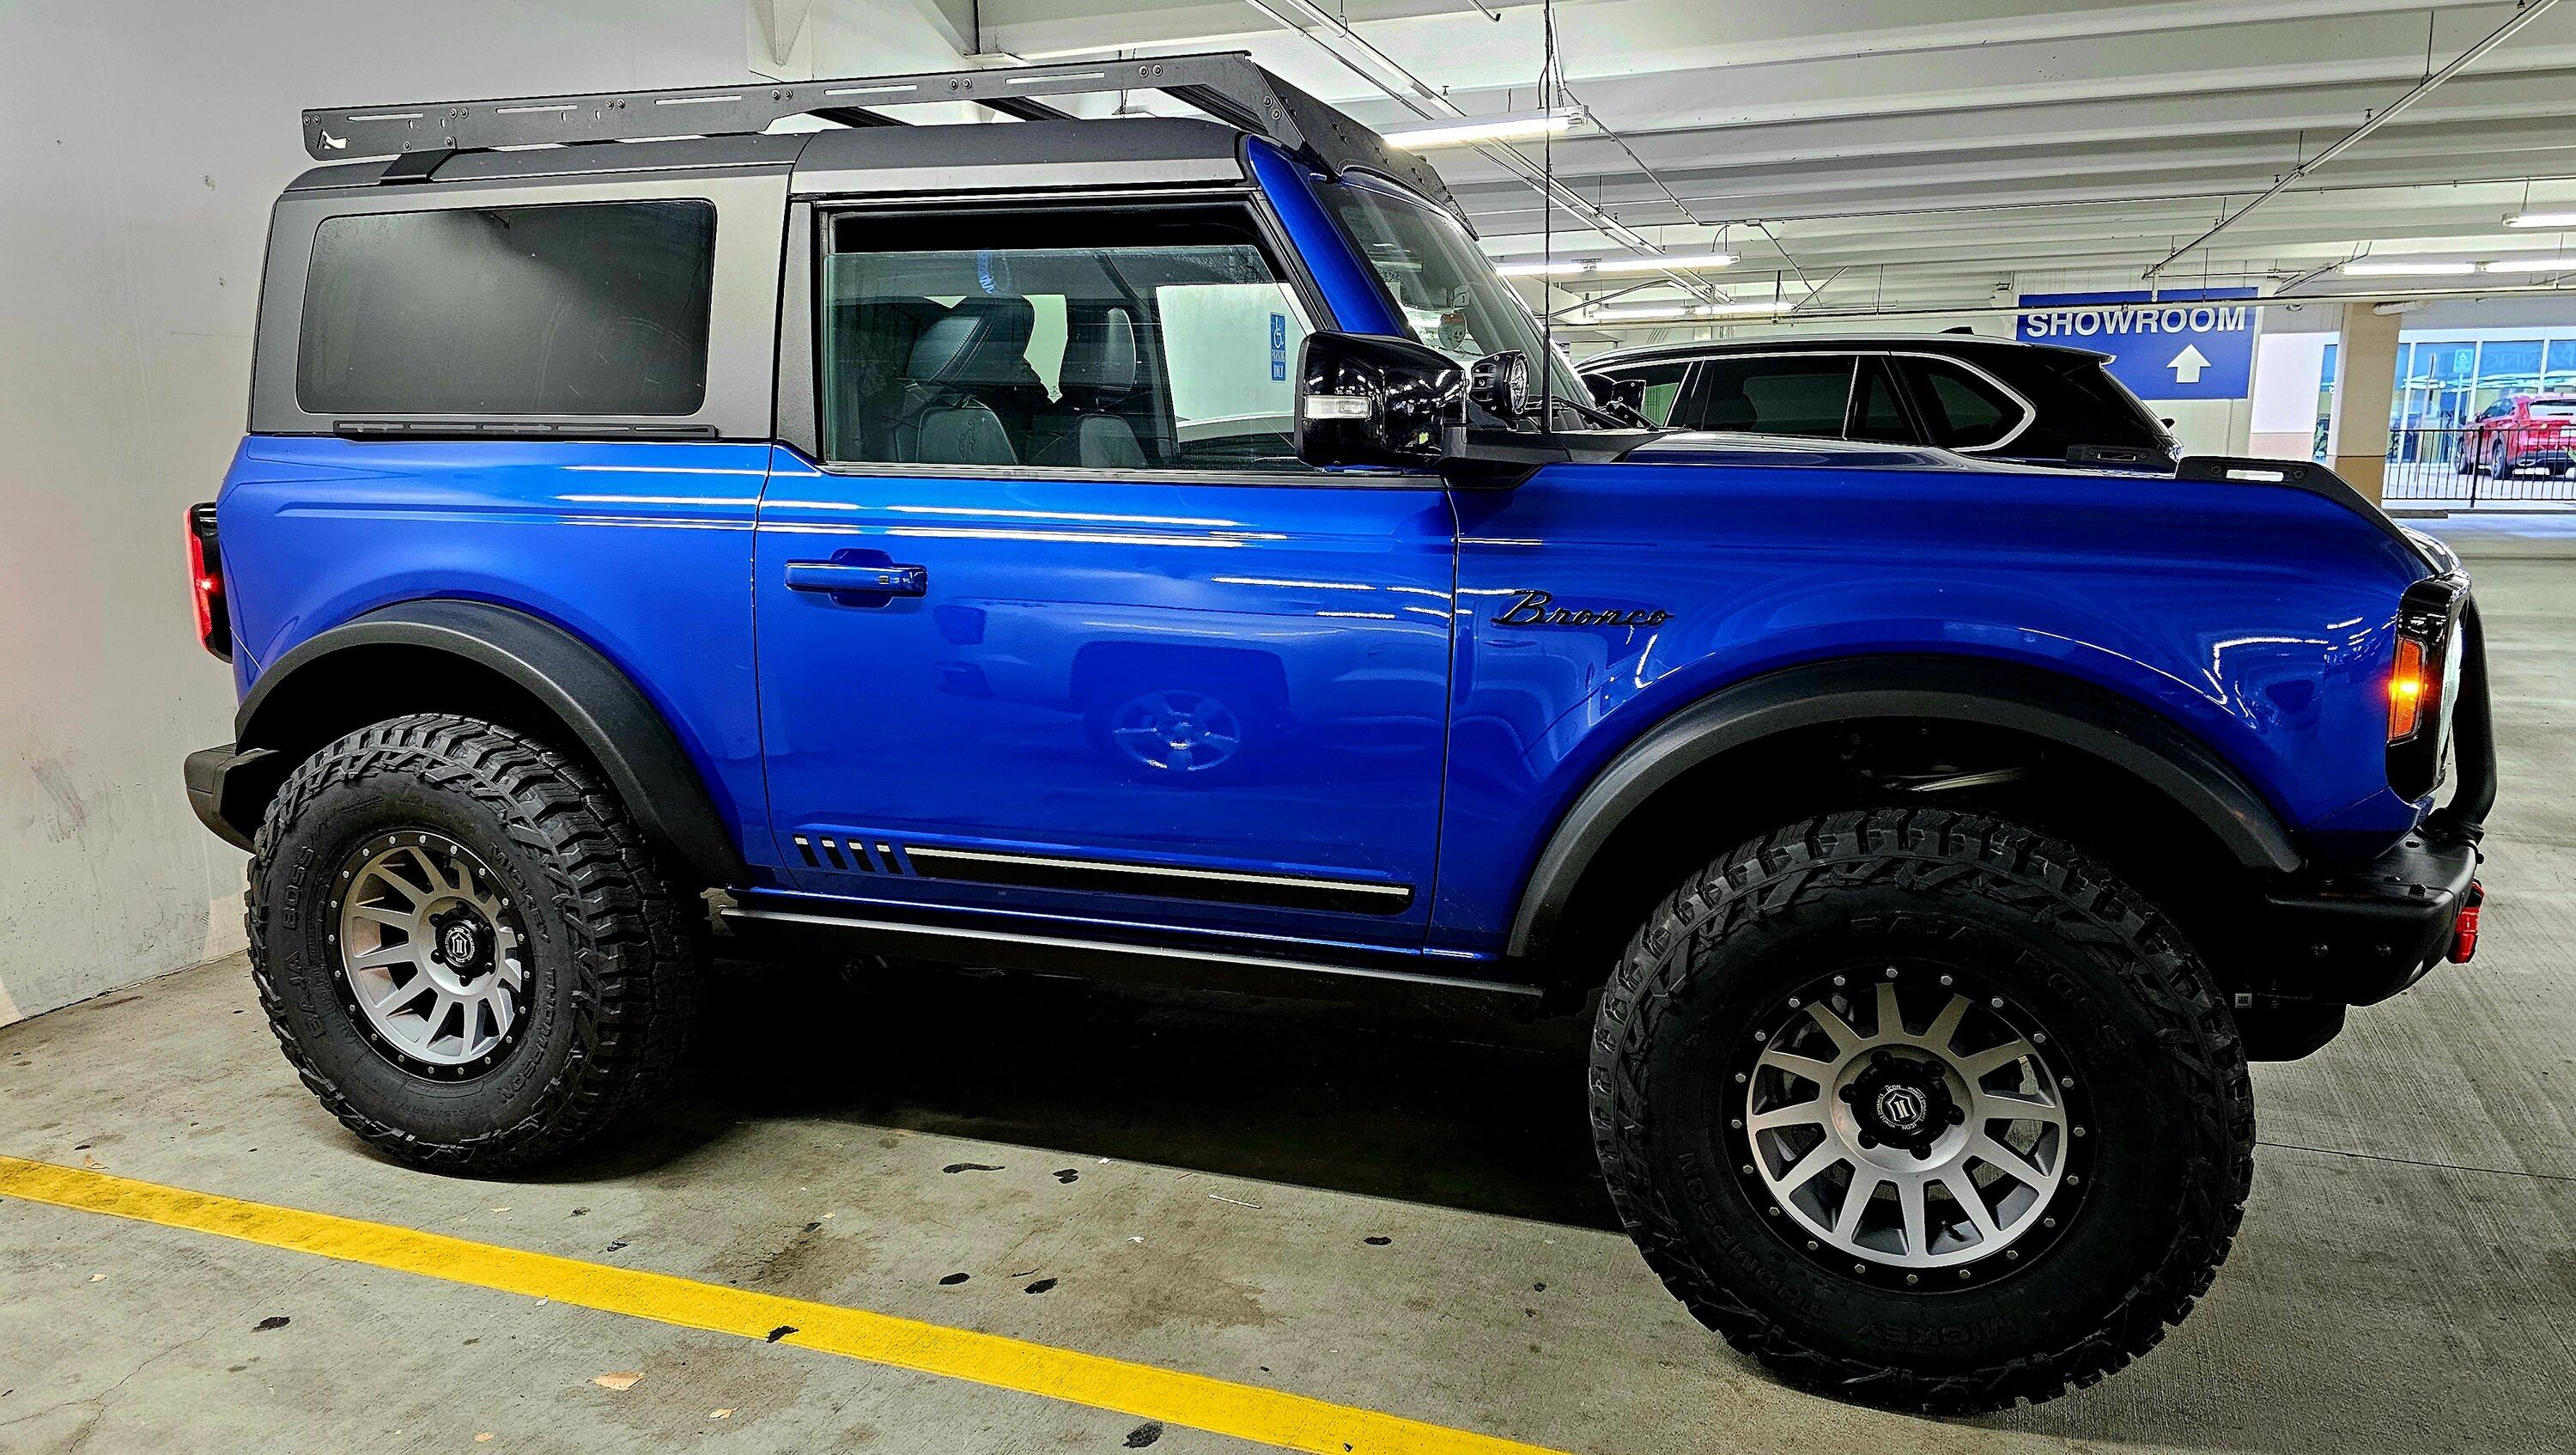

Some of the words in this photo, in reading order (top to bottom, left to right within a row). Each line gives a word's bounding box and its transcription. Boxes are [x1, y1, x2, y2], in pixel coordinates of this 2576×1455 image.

[2026, 307, 2245, 338] SHOWROOM
[1489, 589, 1674, 627] Bronco
[282, 845, 315, 930] BOSS
[490, 841, 550, 943] MICKEY
[284, 950, 327, 1039] BAJA
[502, 967, 556, 1104] THOMPSON
[1886, 1084, 1901, 1093] ICON
